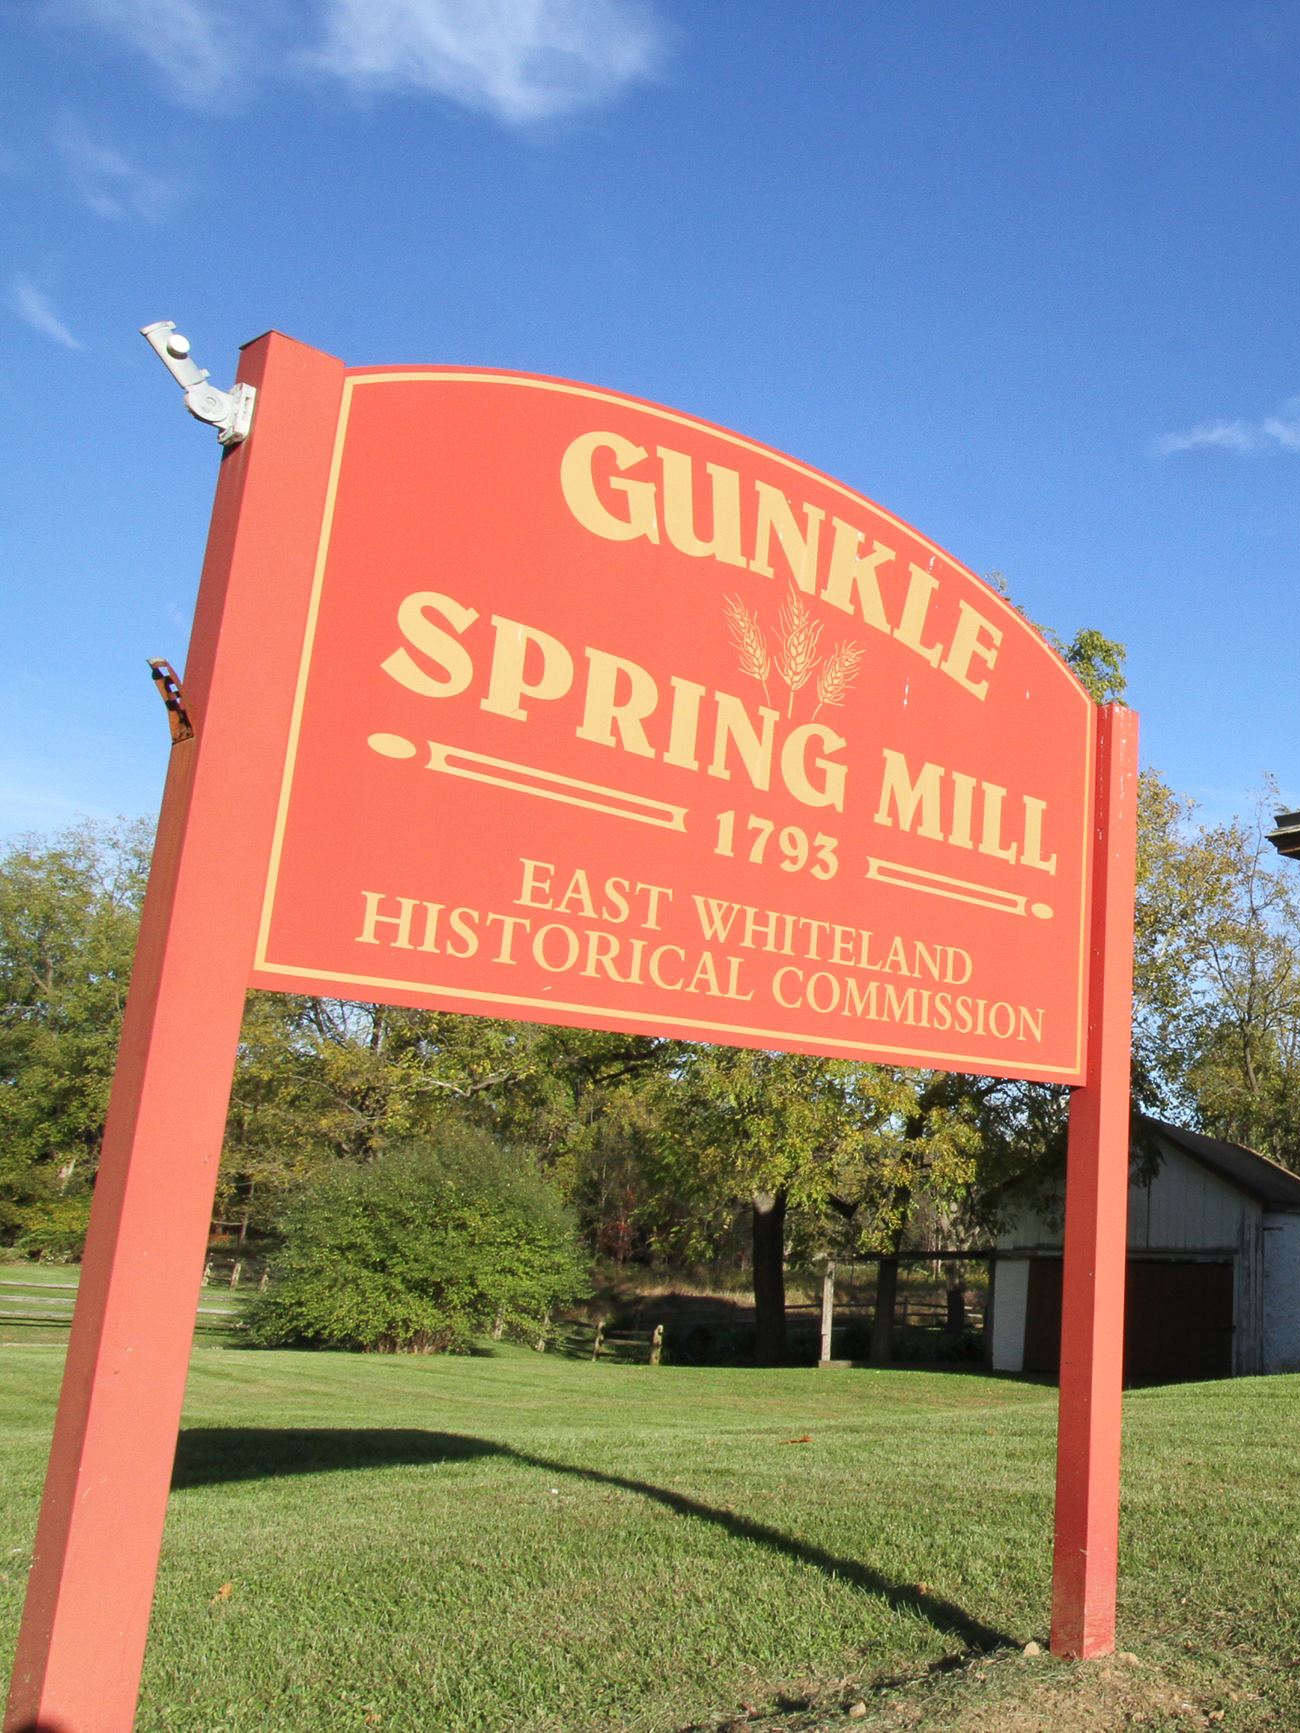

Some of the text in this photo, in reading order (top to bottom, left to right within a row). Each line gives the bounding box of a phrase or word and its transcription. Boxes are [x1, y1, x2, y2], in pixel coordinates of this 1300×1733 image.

[559, 430, 1004, 702] GUNKLE
[379, 591, 1058, 877] SPRING MILL
[512, 857, 973, 985] EAST WHITELAND
[713, 809, 839, 881] 1793
[354, 890, 1046, 1043] HISTORICAL COMMISSION
